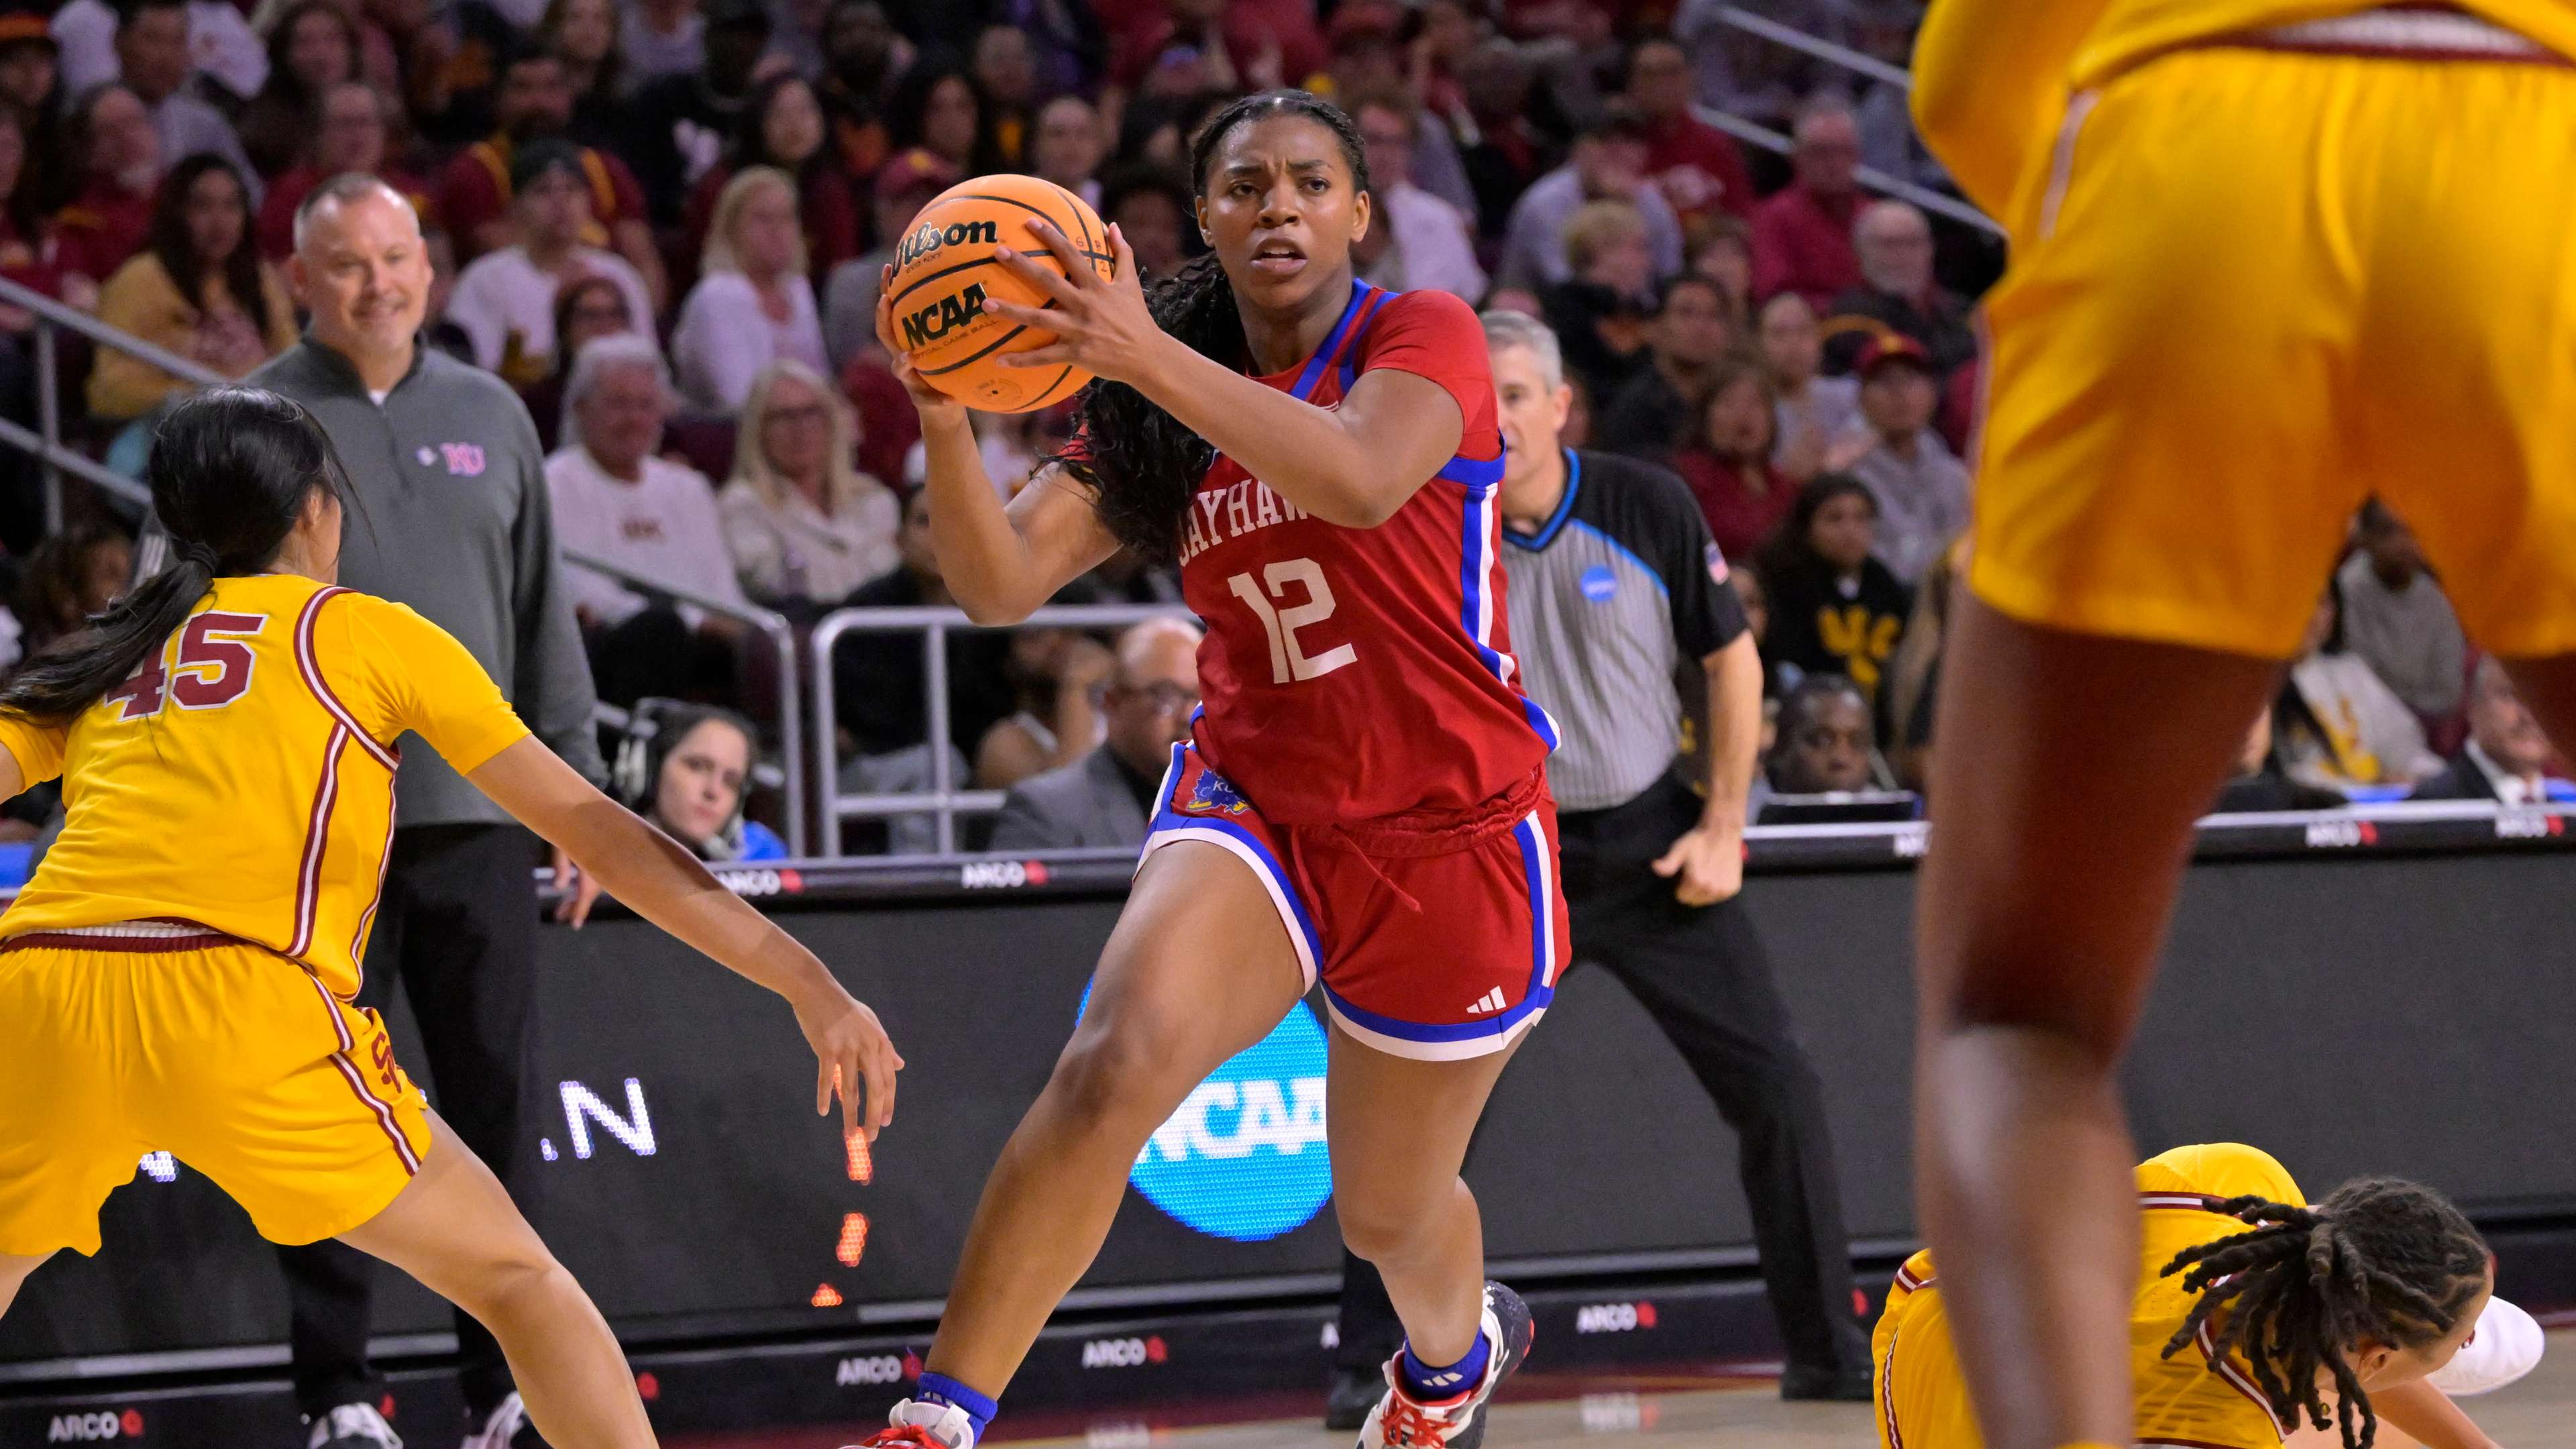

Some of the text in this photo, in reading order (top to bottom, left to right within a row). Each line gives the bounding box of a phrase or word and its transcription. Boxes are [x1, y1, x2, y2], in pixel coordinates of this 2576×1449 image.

[103, 609, 269, 722] 45
[1227, 557, 1358, 684] 12
[48, 1411, 120, 1443] ARCO
